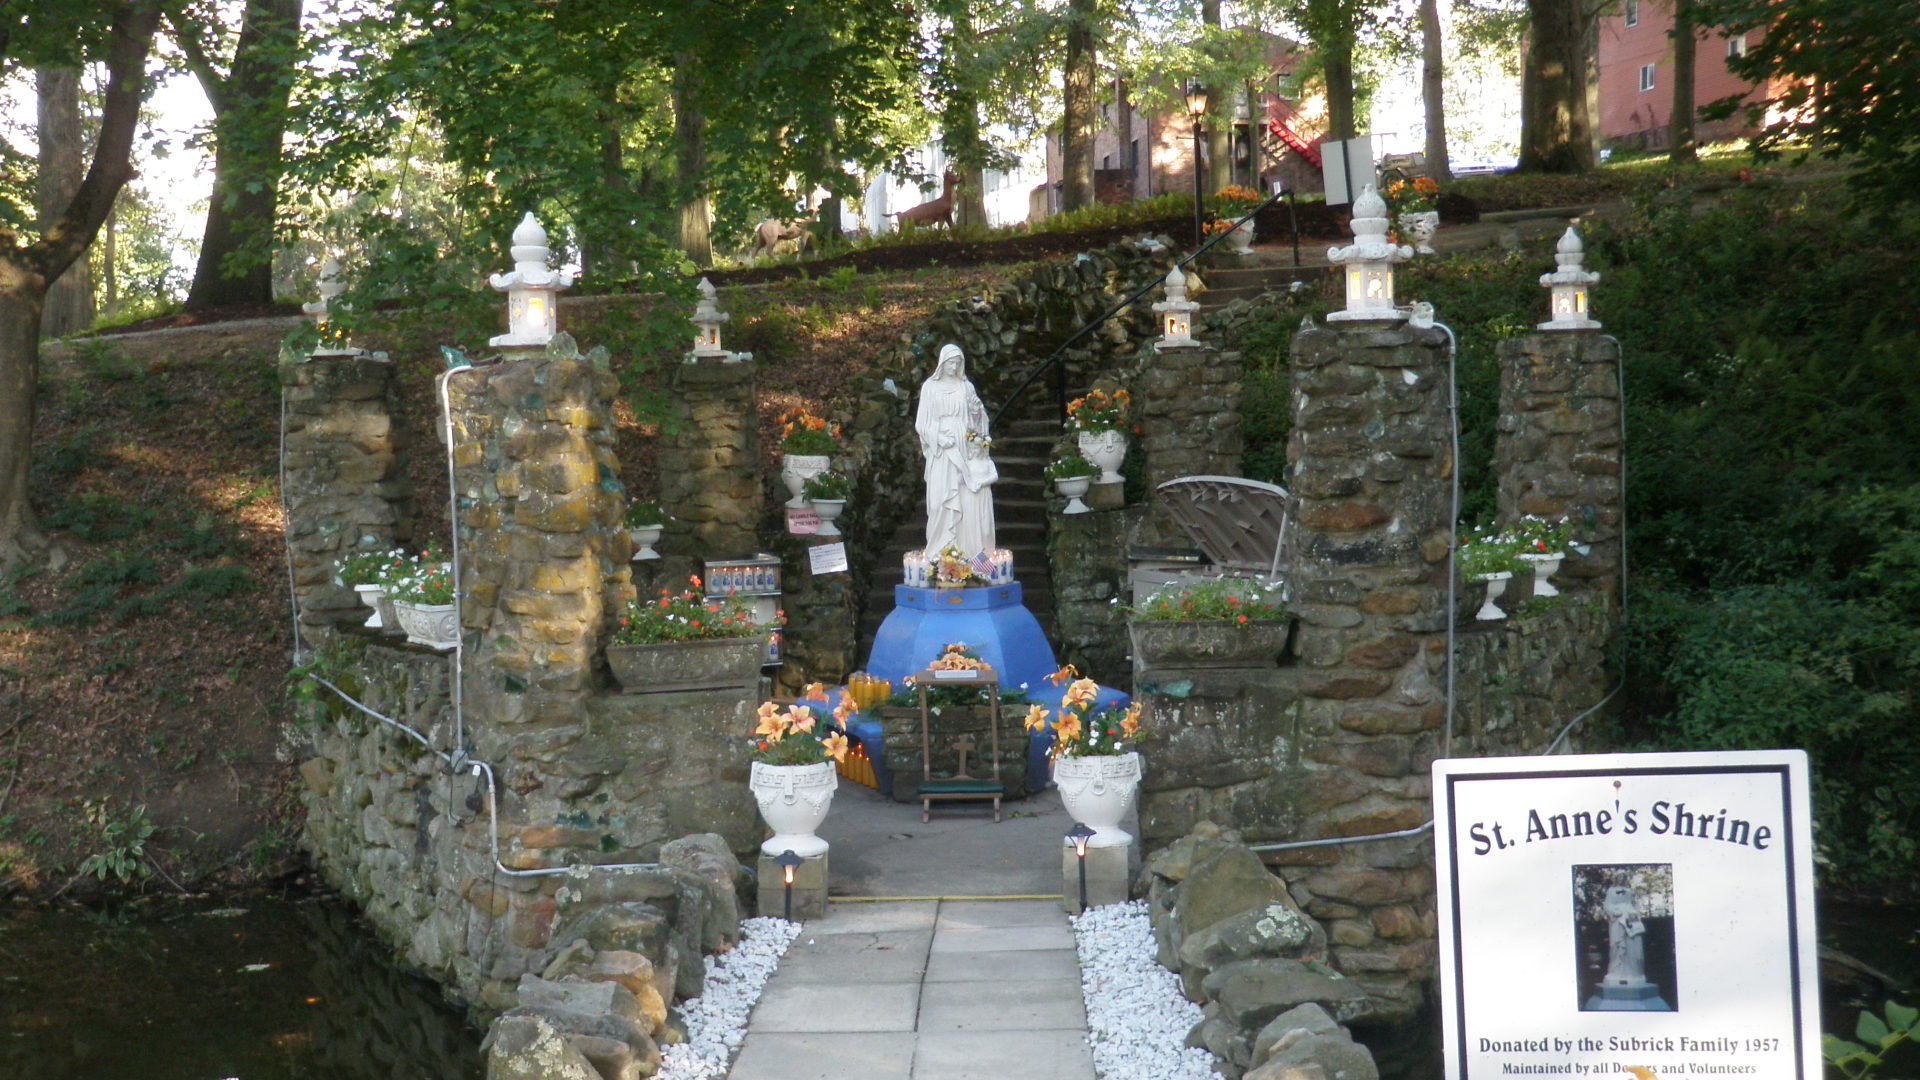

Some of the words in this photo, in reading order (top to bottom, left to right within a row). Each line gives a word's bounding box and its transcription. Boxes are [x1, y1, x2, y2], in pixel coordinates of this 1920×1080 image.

[1470, 821, 1515, 855] St.
[1526, 799, 1638, 842] Anne's
[1649, 801, 1771, 850] Shrine
[1479, 1037, 1548, 1052] Donated
[1554, 1037, 1572, 1055] by
[1578, 1037, 1603, 1052] the
[1609, 1036, 1674, 1052] Subrick
[1680, 1037, 1738, 1055] Family
[1745, 1038, 1779, 1052] 1957
[1502, 1063, 1571, 1074] Maintained
[1575, 1063, 1590, 1076] by
[1593, 1063, 1608, 1073] all
[1613, 1062, 1658, 1074] Dors
[1661, 1063, 1685, 1074] and
[1689, 1063, 1756, 1074] Volunteers
